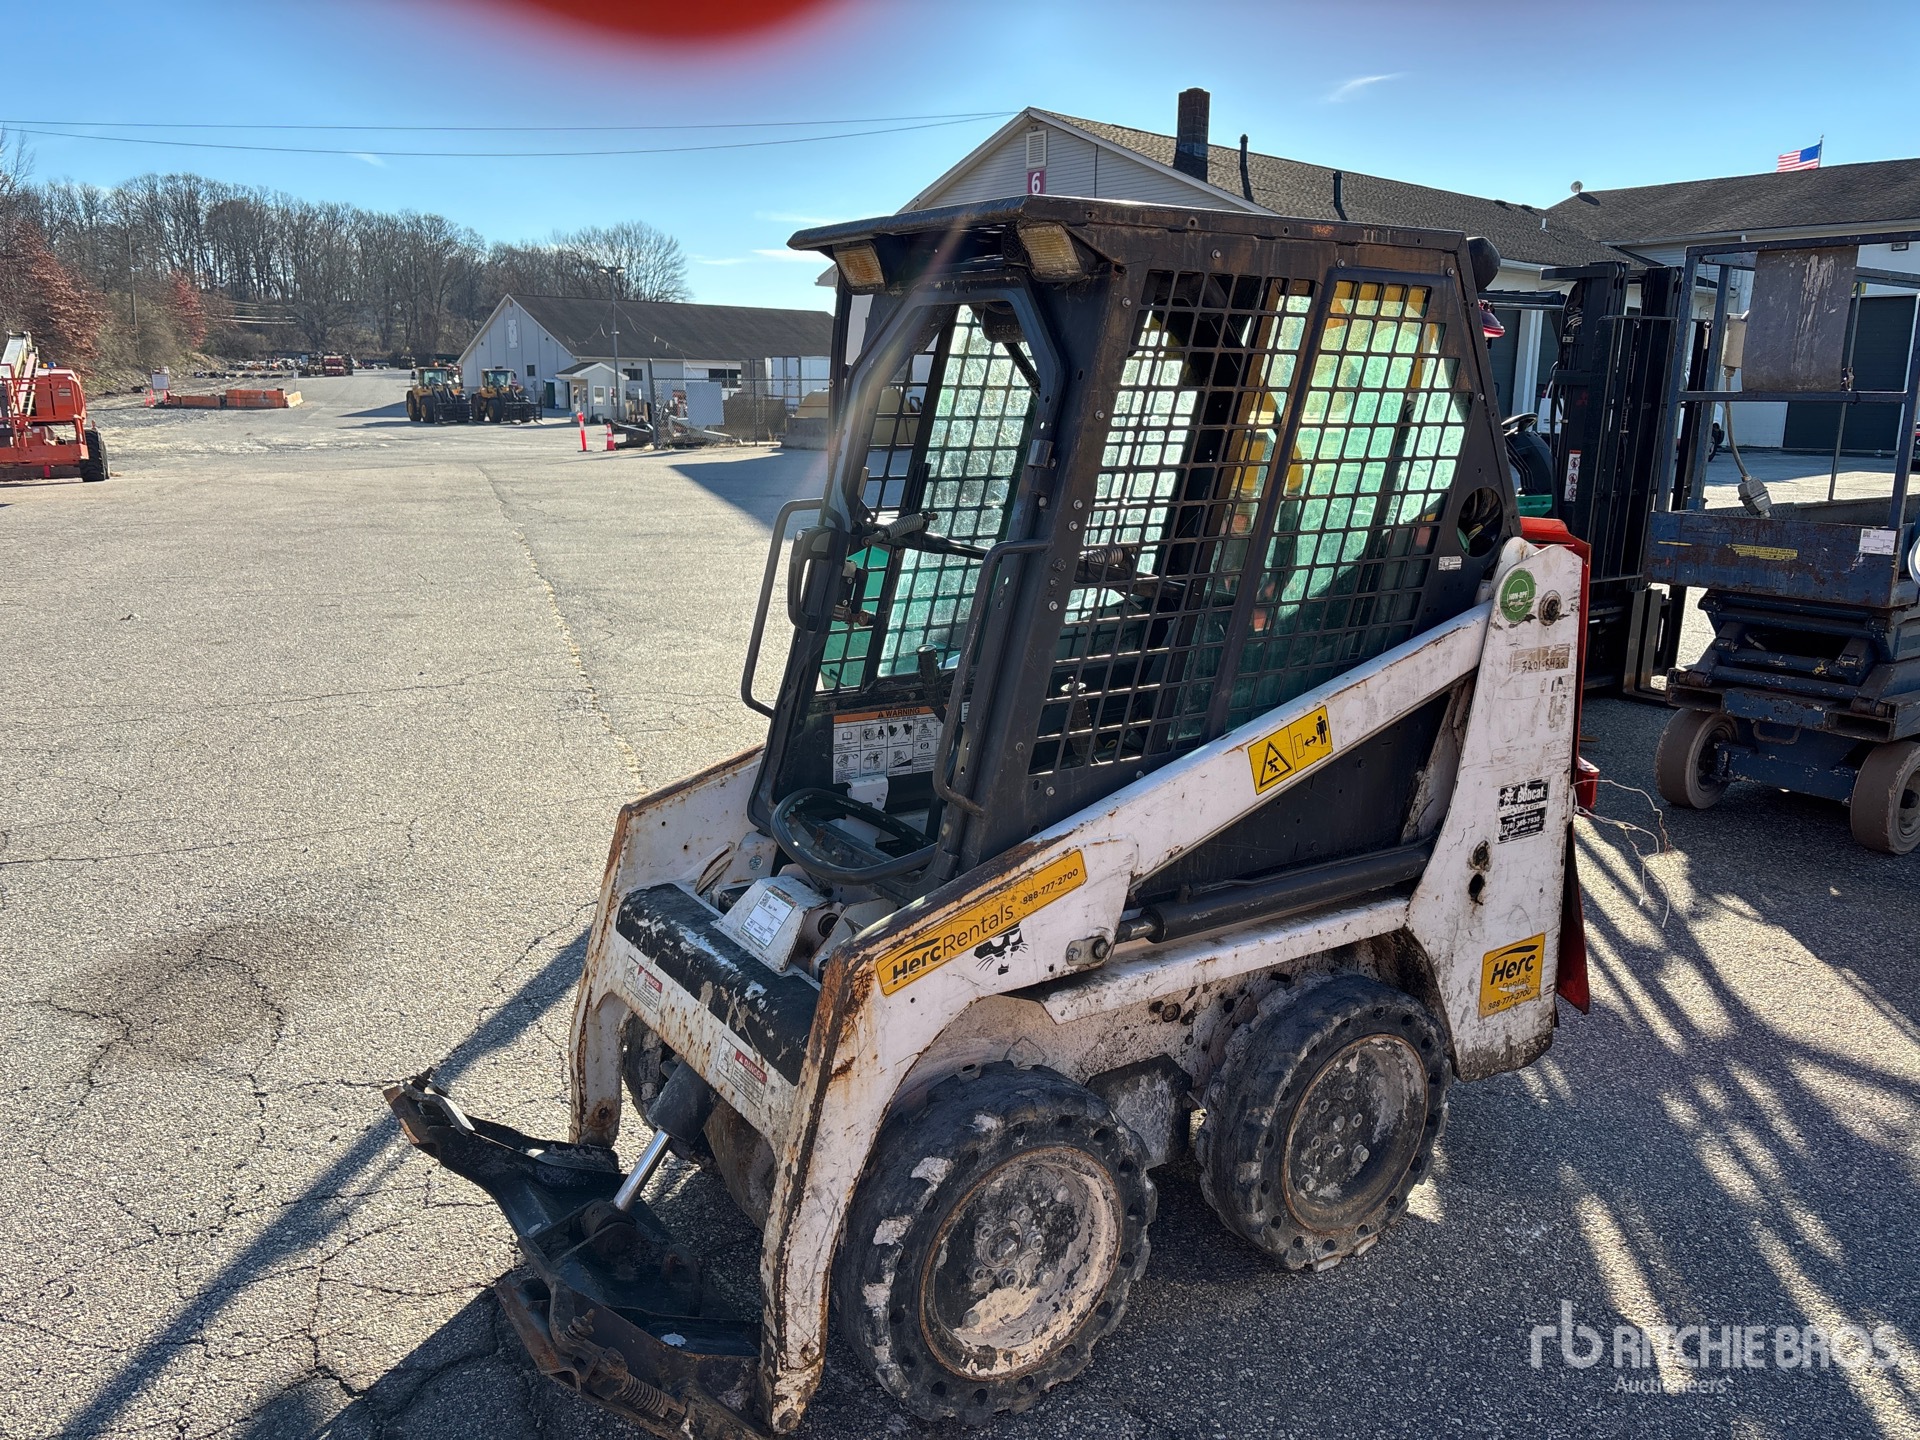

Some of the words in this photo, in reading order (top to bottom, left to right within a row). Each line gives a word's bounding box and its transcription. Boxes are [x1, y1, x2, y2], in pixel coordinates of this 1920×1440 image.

[1031, 172, 1041, 194] 6
[885, 707, 921, 718] WARNING
[1517, 785, 1544, 804] Bobcat
[1022, 868, 1079, 905] 888-777-2700
[1490, 954, 1537, 986] Herc
[743, 1057, 764, 1081] DANGER
